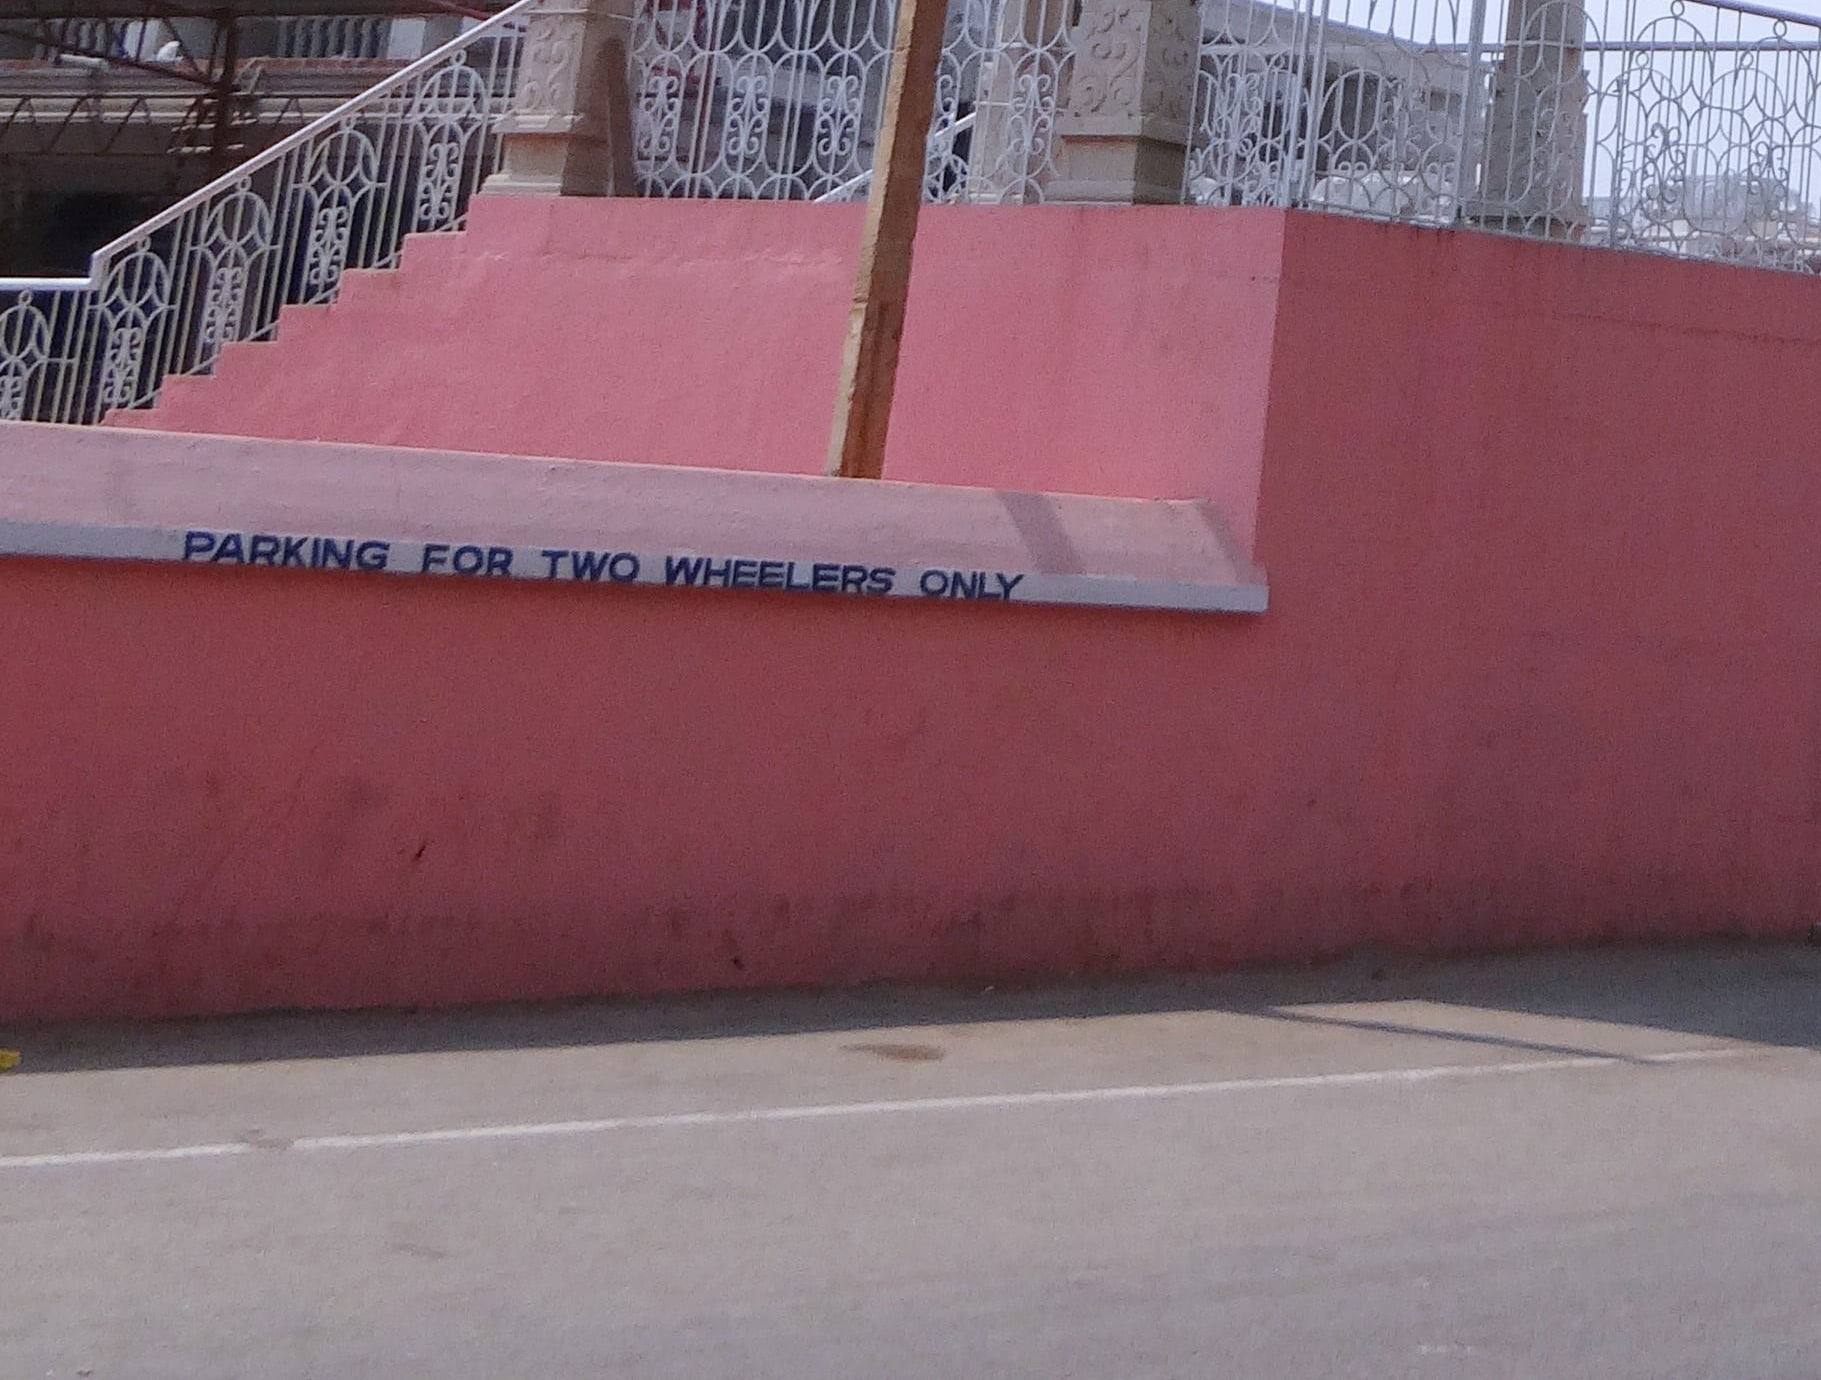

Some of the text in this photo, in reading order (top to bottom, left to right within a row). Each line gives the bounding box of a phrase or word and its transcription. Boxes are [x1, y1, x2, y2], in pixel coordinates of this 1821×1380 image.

[183, 530, 1025, 601] PARKING FOR TWO WHEELERS ONLY
